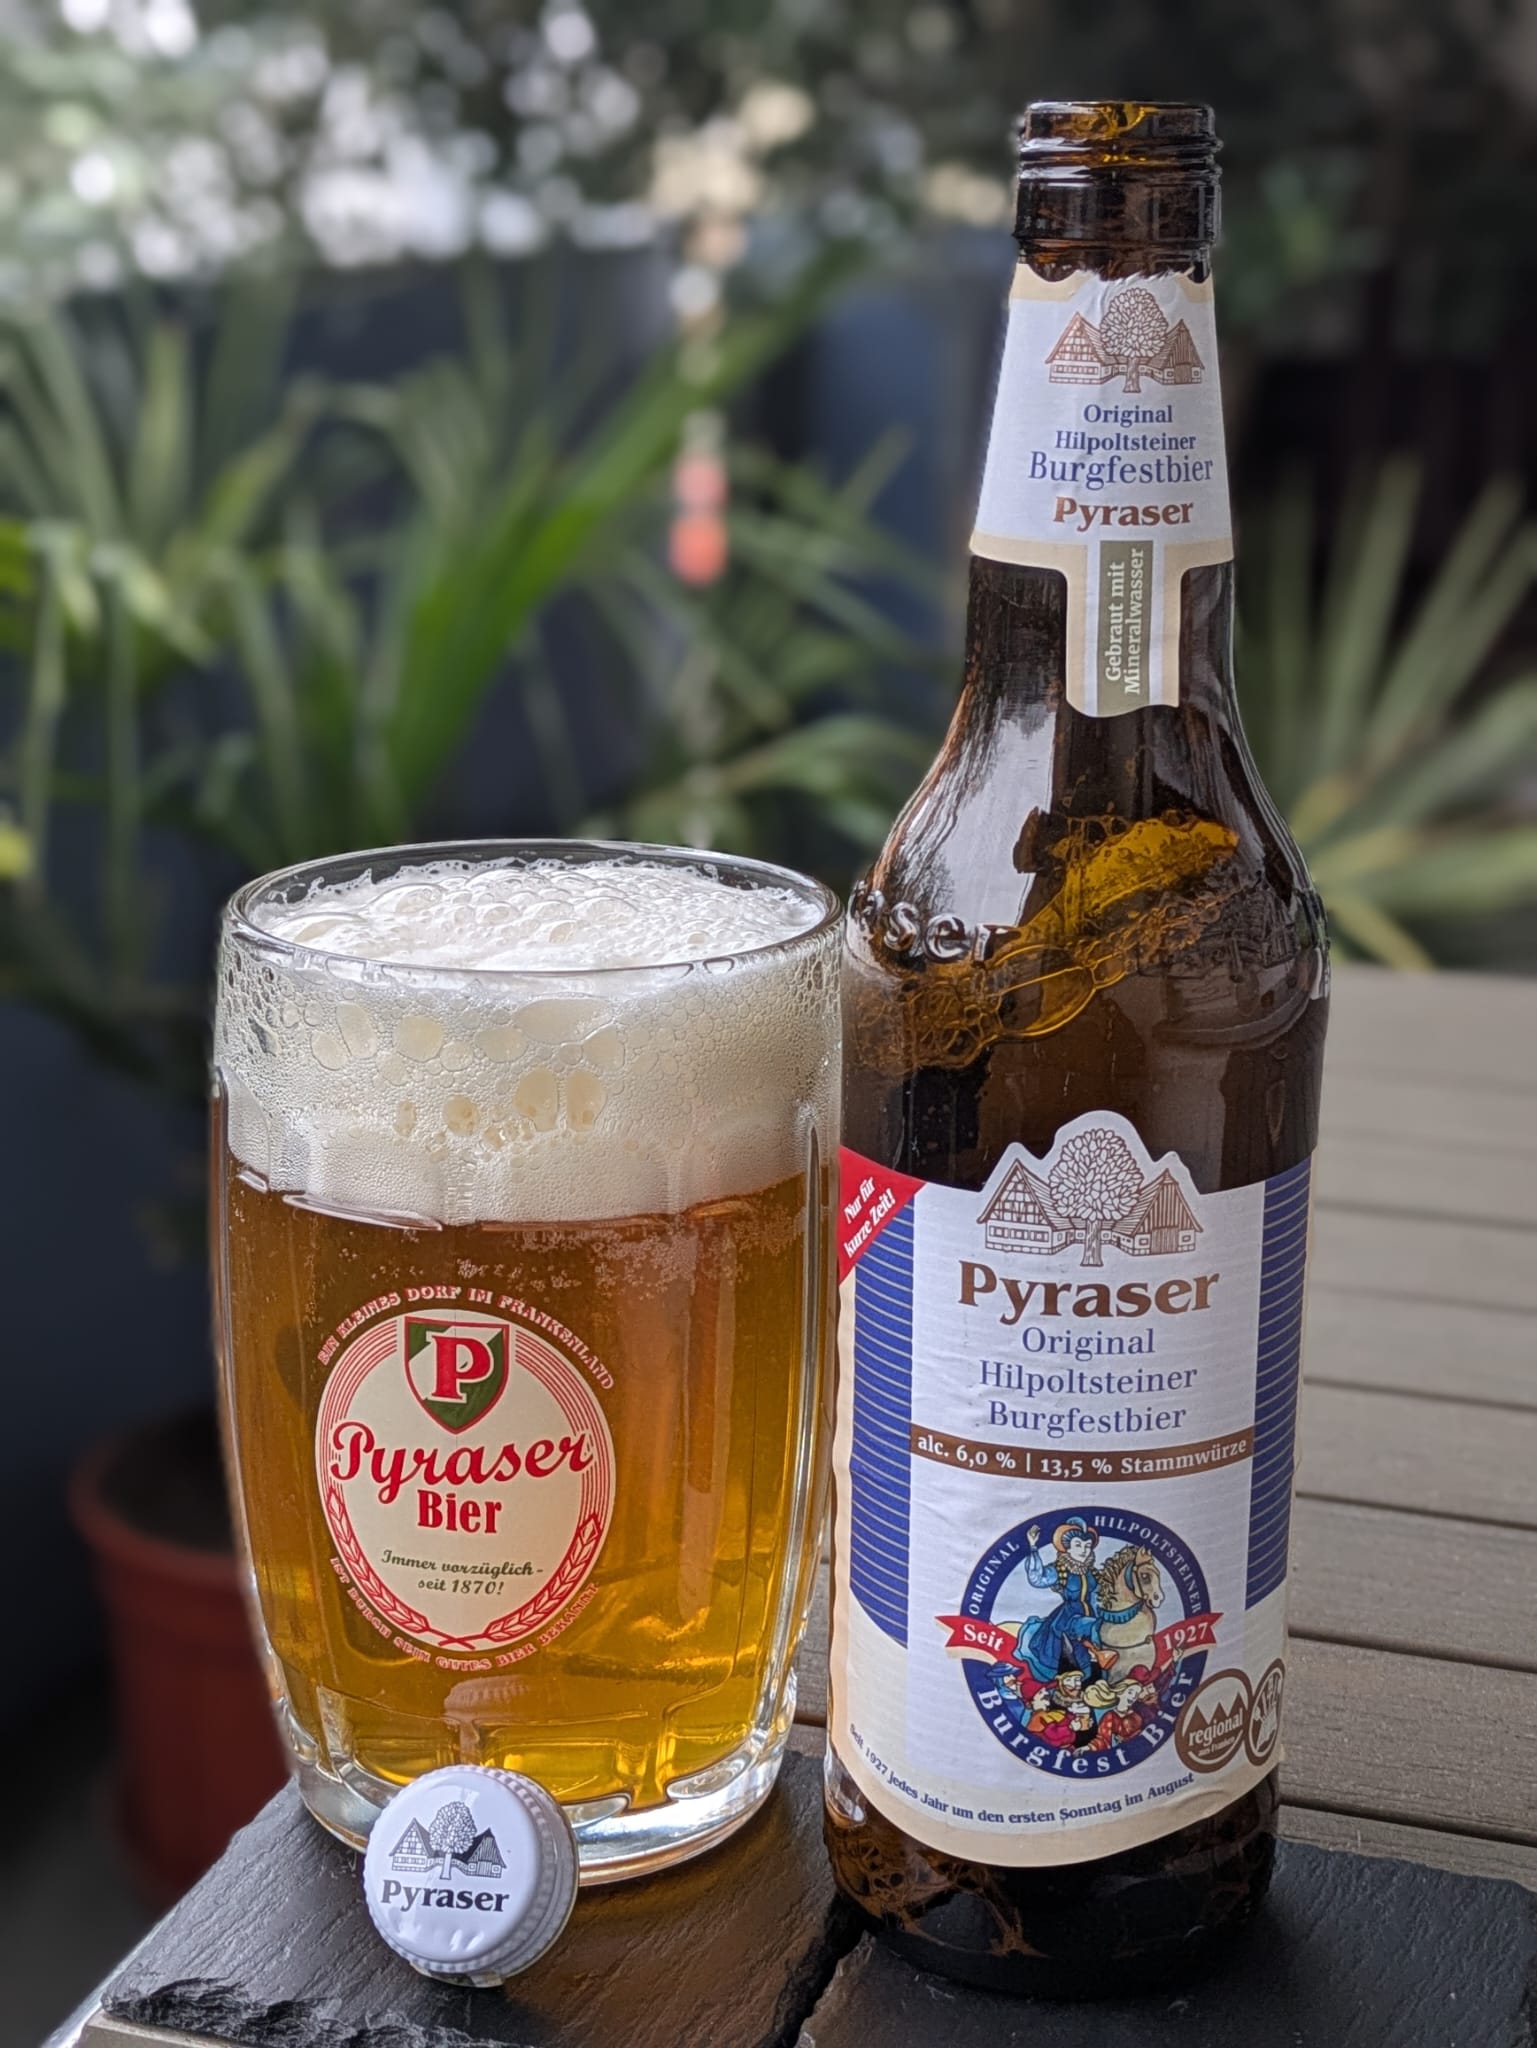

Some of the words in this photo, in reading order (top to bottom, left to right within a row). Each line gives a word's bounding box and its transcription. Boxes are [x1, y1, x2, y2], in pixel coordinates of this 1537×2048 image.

[1083, 404, 1173, 427] Original
[1054, 430, 1196, 456] Hilpoltsteiner
[1028, 451, 1213, 490] Burgfestbier
[1053, 496, 1194, 531] Pyraser
[1106, 561, 1124, 600] mit
[1124, 547, 1145, 696] Mineralwasser
[1105, 605, 1123, 682] Gebraut
[844, 1195, 862, 1224] Nur
[859, 1176, 875, 1203] für
[843, 1220, 872, 1259] kurze
[869, 1188, 896, 1226] Zeit!
[957, 1260, 1220, 1326] Pyraser
[336, 1291, 402, 1339] KLEINES
[404, 1285, 462, 1302] DORF
[468, 1286, 492, 1305] IM
[498, 1295, 615, 1390] FRANKENLAND
[1022, 1327, 1155, 1361] Original
[430, 1334, 493, 1402] P
[979, 1360, 1197, 1398] Hilpoltsteiner
[988, 1400, 1187, 1438] Burgfestbier
[331, 1421, 594, 1504] Pyraser
[917, 1435, 949, 1457] alc.
[956, 1446, 988, 1468] 6,0
[995, 1452, 1017, 1471] %
[1040, 1457, 1083, 1478] 13,5
[1091, 1457, 1113, 1475] %
[1121, 1438, 1247, 1475] Stammwürze
[417, 1489, 502, 1534] Bier
[381, 1549, 437, 1571] Immer
[969, 1542, 1020, 1615] ORIGINAL
[1095, 1515, 1202, 1613] HILPOLTSTEINER
[418, 1578, 446, 1592] seit
[452, 1580, 504, 1595] 1870!
[330, 1557, 350, 1584] IST
[347, 1587, 392, 1639] DURCH
[393, 1636, 431, 1663] SEIN
[435, 1656, 492, 1671] GUTES
[495, 1643, 537, 1667] BIER
[537, 1582, 599, 1646] BEKANNT
[963, 1623, 1004, 1651] Seit
[1162, 1622, 1208, 1651] 1927
[977, 1690, 1130, 1774] Burgfest
[1141, 1672, 1194, 1747] Bier
[1188, 1707, 1243, 1747] regional
[850, 1723, 864, 1749] Seit
[865, 1748, 888, 1775] 1927
[887, 1771, 919, 1799] jedes
[920, 1793, 950, 1813] Jahr
[952, 1806, 974, 1819] um
[978, 1809, 1004, 1823] den
[1008, 1811, 1055, 1823] ersten
[1059, 1799, 1122, 1821] Sonntag
[1125, 1794, 1143, 1807] im
[1148, 1772, 1195, 1800] August
[380, 1879, 510, 1912] Pyraser
